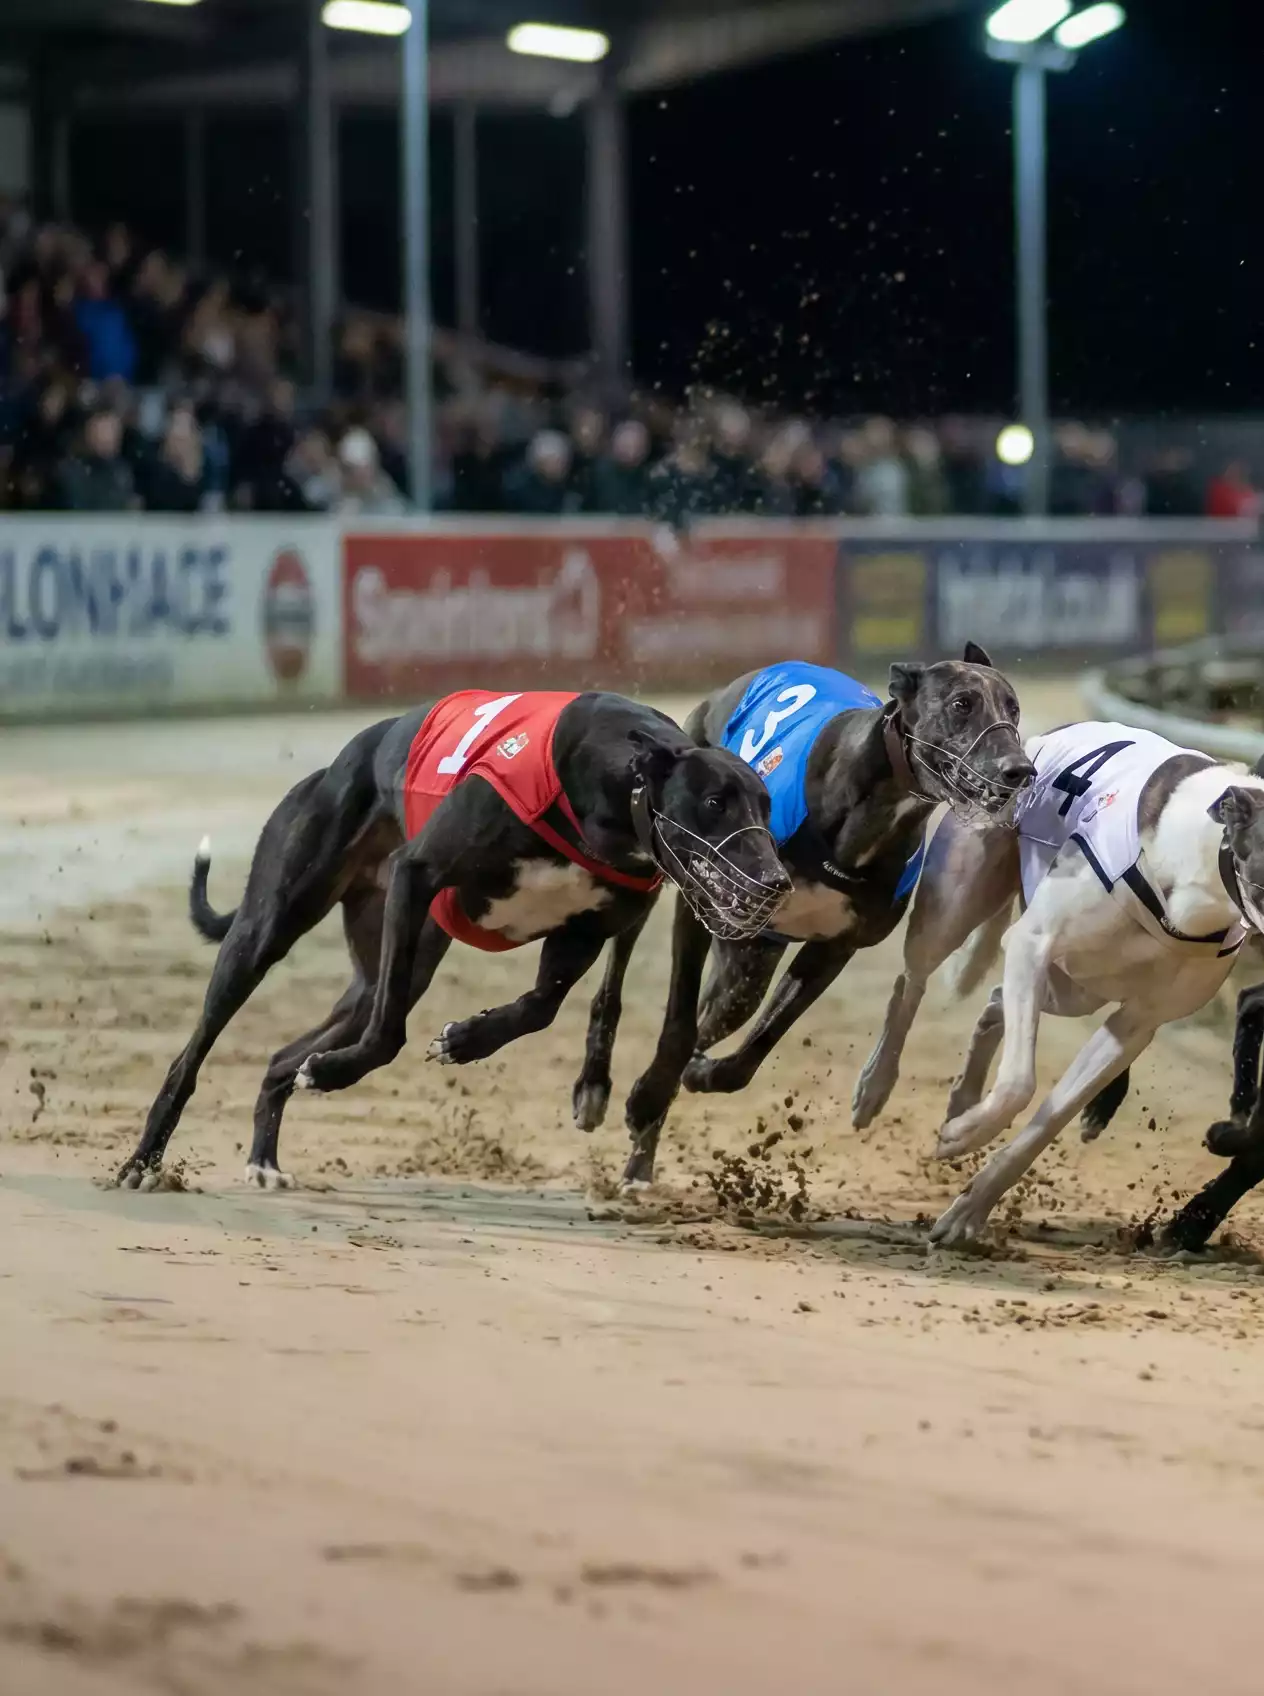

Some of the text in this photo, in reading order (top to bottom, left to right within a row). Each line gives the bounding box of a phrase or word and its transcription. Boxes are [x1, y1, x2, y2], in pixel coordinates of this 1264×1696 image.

[436, 692, 523, 775] 1
[738, 683, 818, 764] 3
[1051, 739, 1137, 817] 4
